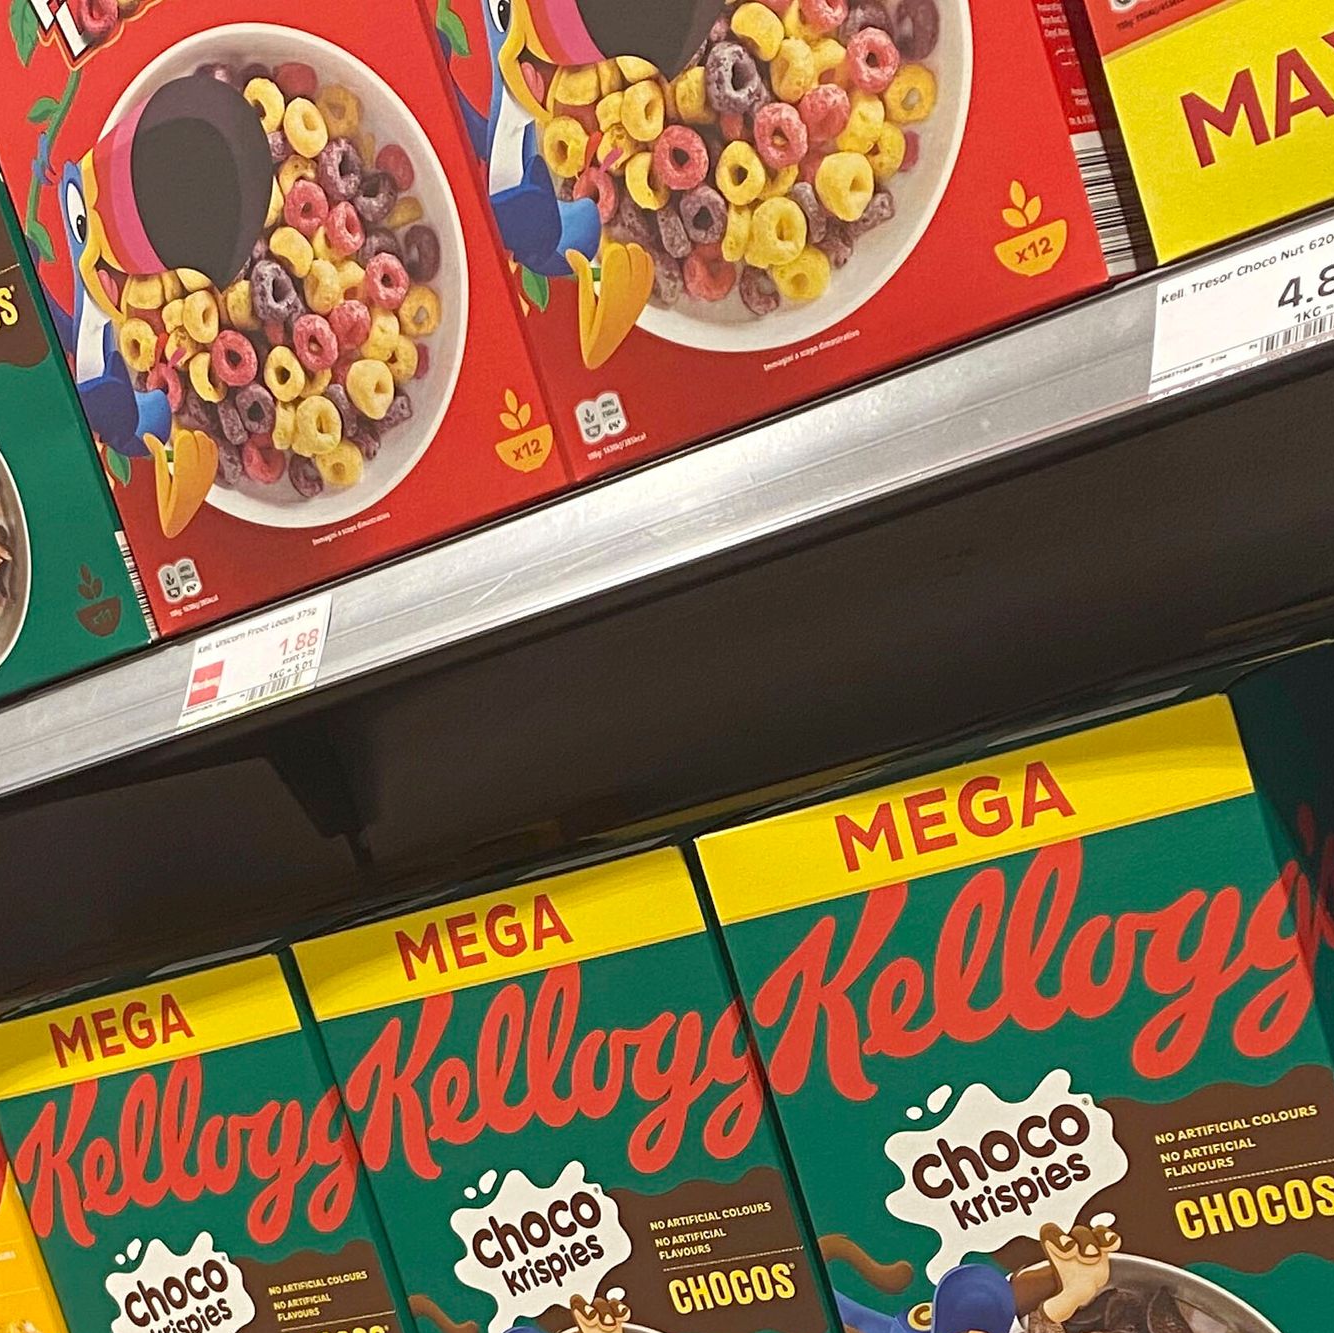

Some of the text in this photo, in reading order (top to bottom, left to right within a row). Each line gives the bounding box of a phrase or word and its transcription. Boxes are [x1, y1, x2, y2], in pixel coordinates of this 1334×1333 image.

[1191, 271, 1233, 293] Tresor
[1237, 255, 1277, 275] Choco
[1281, 245, 1305, 260] Nut
[512, 439, 544, 460] x12
[280, 628, 319, 656] 1.88
[834, 761, 1076, 873] MEGA
[394, 893, 574, 982] MEGA
[48, 993, 196, 1068] MEGA
[911, 1103, 1091, 1200] choco
[1154, 1105, 1317, 1145] NO ARTIFICIAL COLOURS
[951, 1152, 1091, 1230] krispies
[1164, 1157, 1235, 1178] FLAVOURS
[472, 1190, 603, 1271] choco
[650, 1202, 771, 1231] NO ARTIFICIAL COLOURS
[502, 1234, 605, 1299] krispies
[658, 1244, 712, 1260] FLAVOURS
[124, 1258, 229, 1325] choco
[277, 1307, 321, 1322] FLAVOURS
[668, 1262, 796, 1315] CHOCOS
